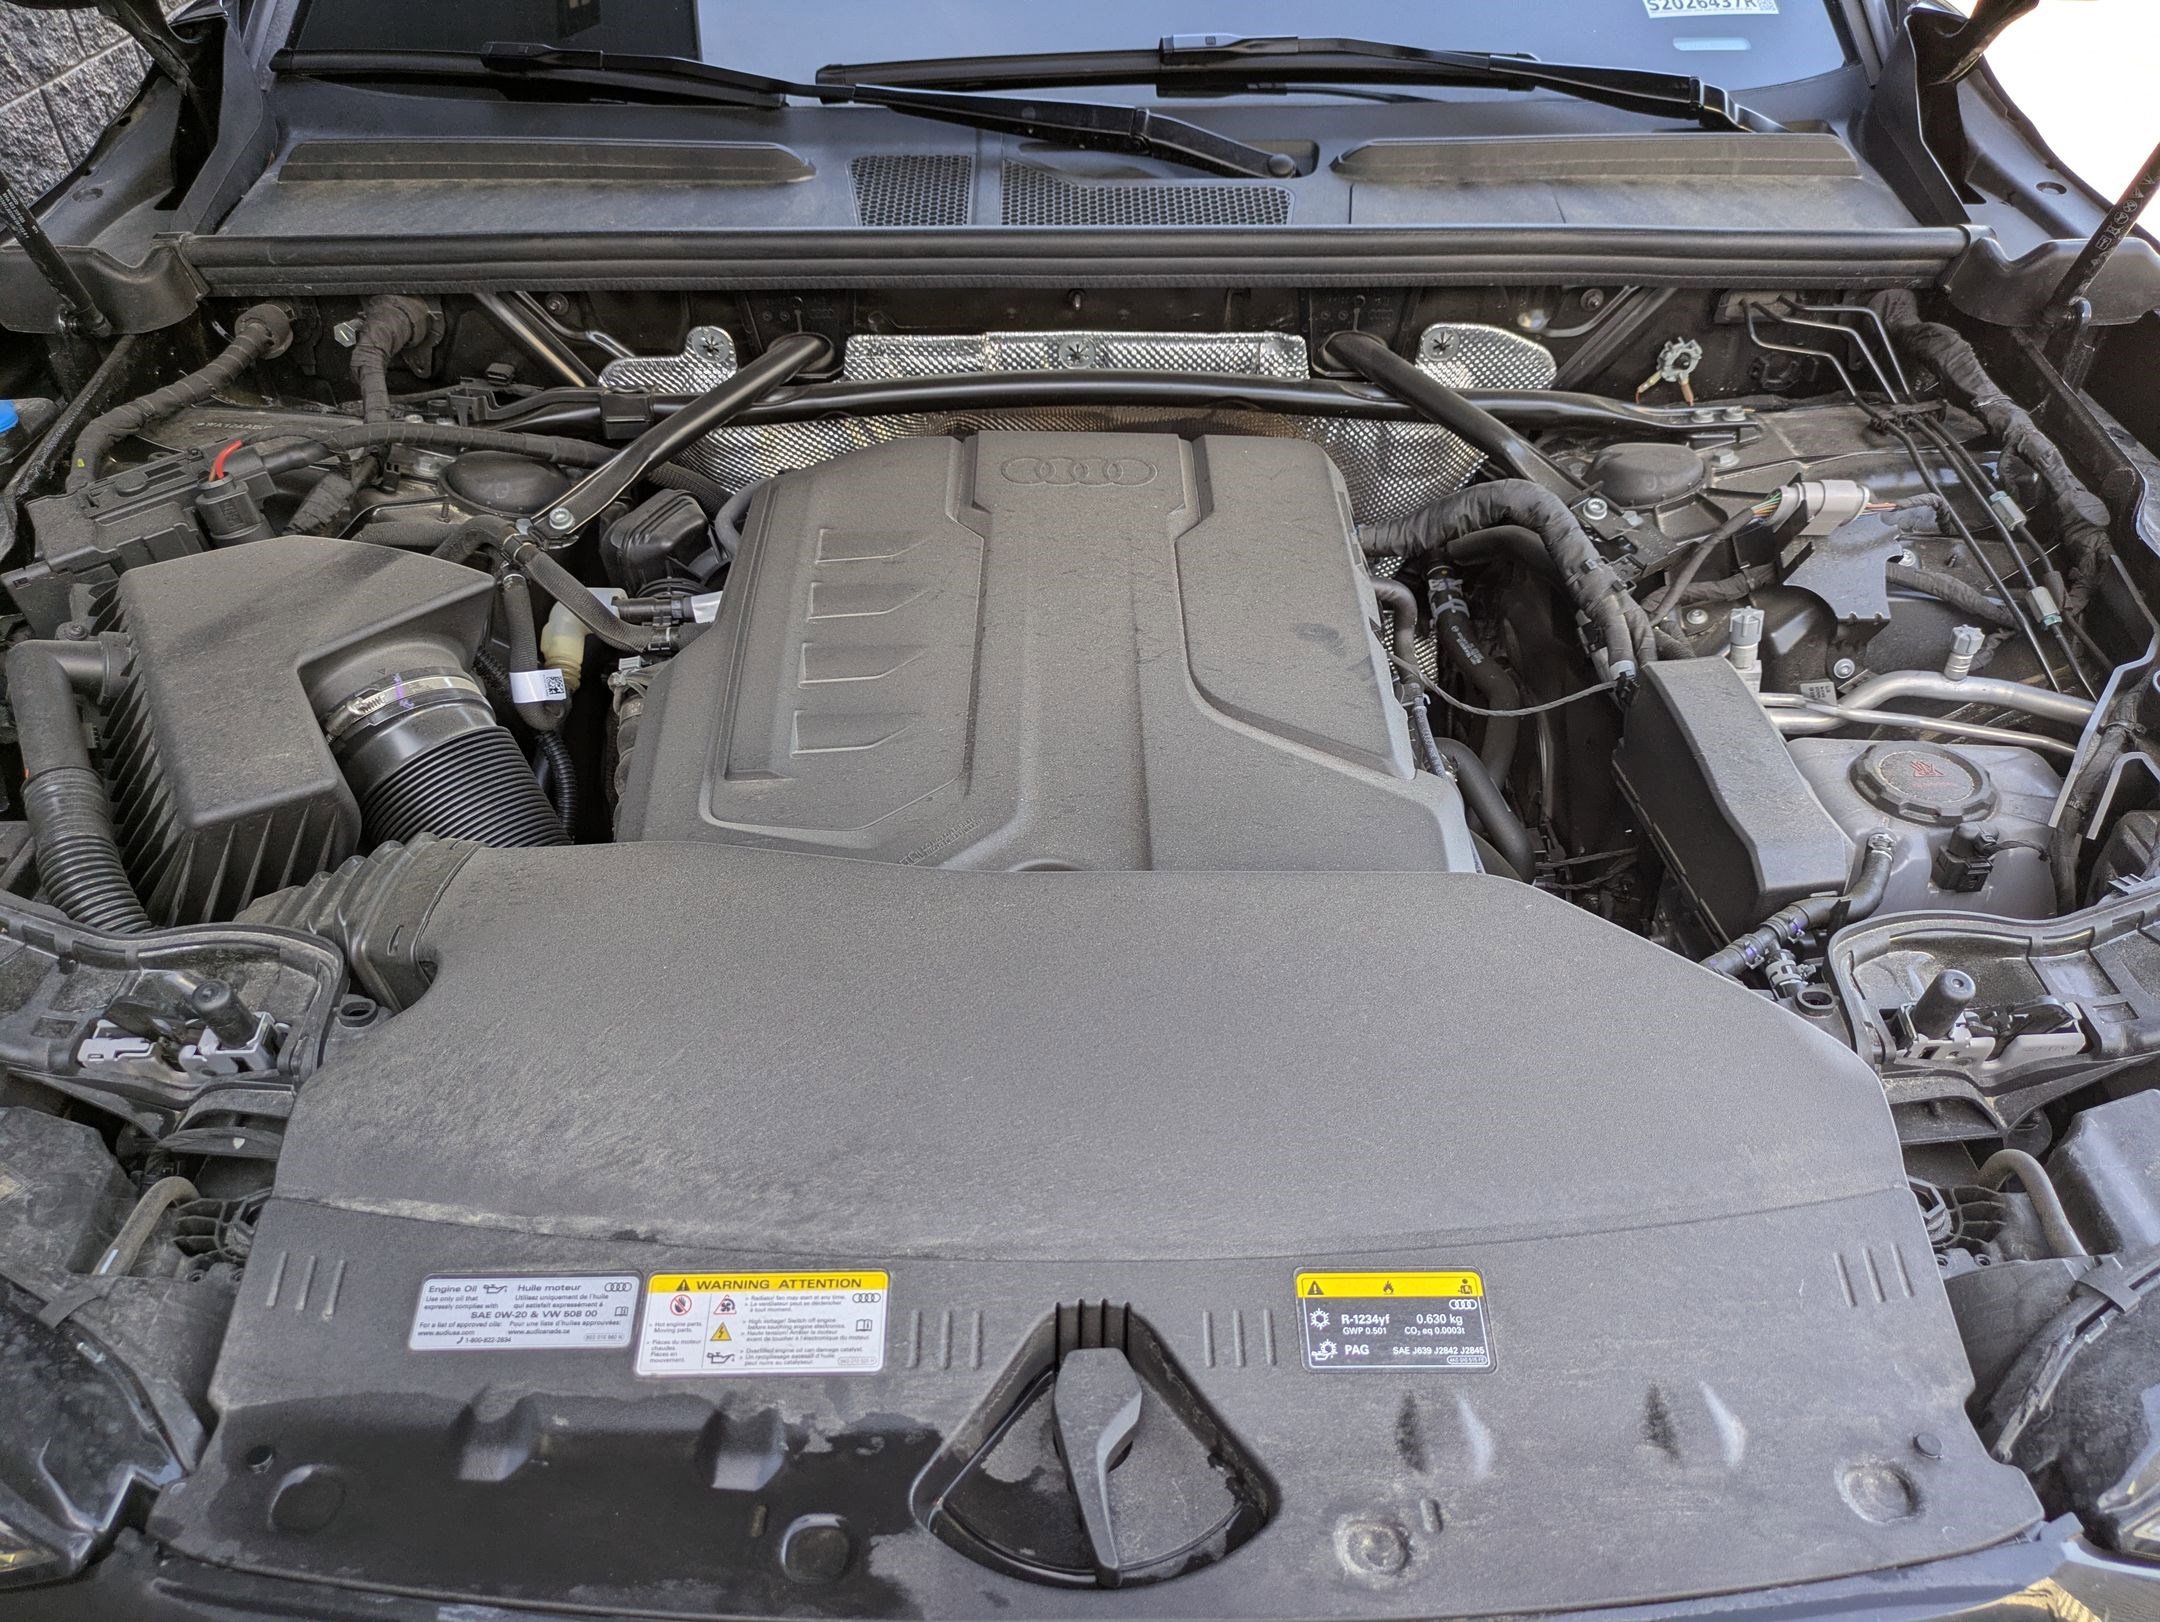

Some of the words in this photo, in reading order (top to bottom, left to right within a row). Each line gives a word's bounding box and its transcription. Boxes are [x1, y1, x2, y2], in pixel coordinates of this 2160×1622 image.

[697, 1279, 770, 1290] WARNING
[778, 1278, 862, 1289] ATTENTION
[429, 1285, 461, 1294] Engine
[471, 1311, 492, 1319] SAE
[1341, 1313, 1390, 1326] R-1234yf
[1416, 1313, 1446, 1325] 0.630
[1449, 1313, 1463, 1326] kg
[456, 1321, 487, 1329] approved
[1343, 1327, 1363, 1335] GWP
[1365, 1327, 1387, 1335] 0.501
[1422, 1327, 1434, 1336] eq
[1434, 1326, 1466, 1335] 0.0003t
[1344, 1344, 1370, 1355] PAG
[1392, 1346, 1411, 1355] SAE
[1412, 1346, 1432, 1355] J639
[1434, 1346, 1458, 1355] J2842
[1460, 1346, 1485, 1355] J2845
